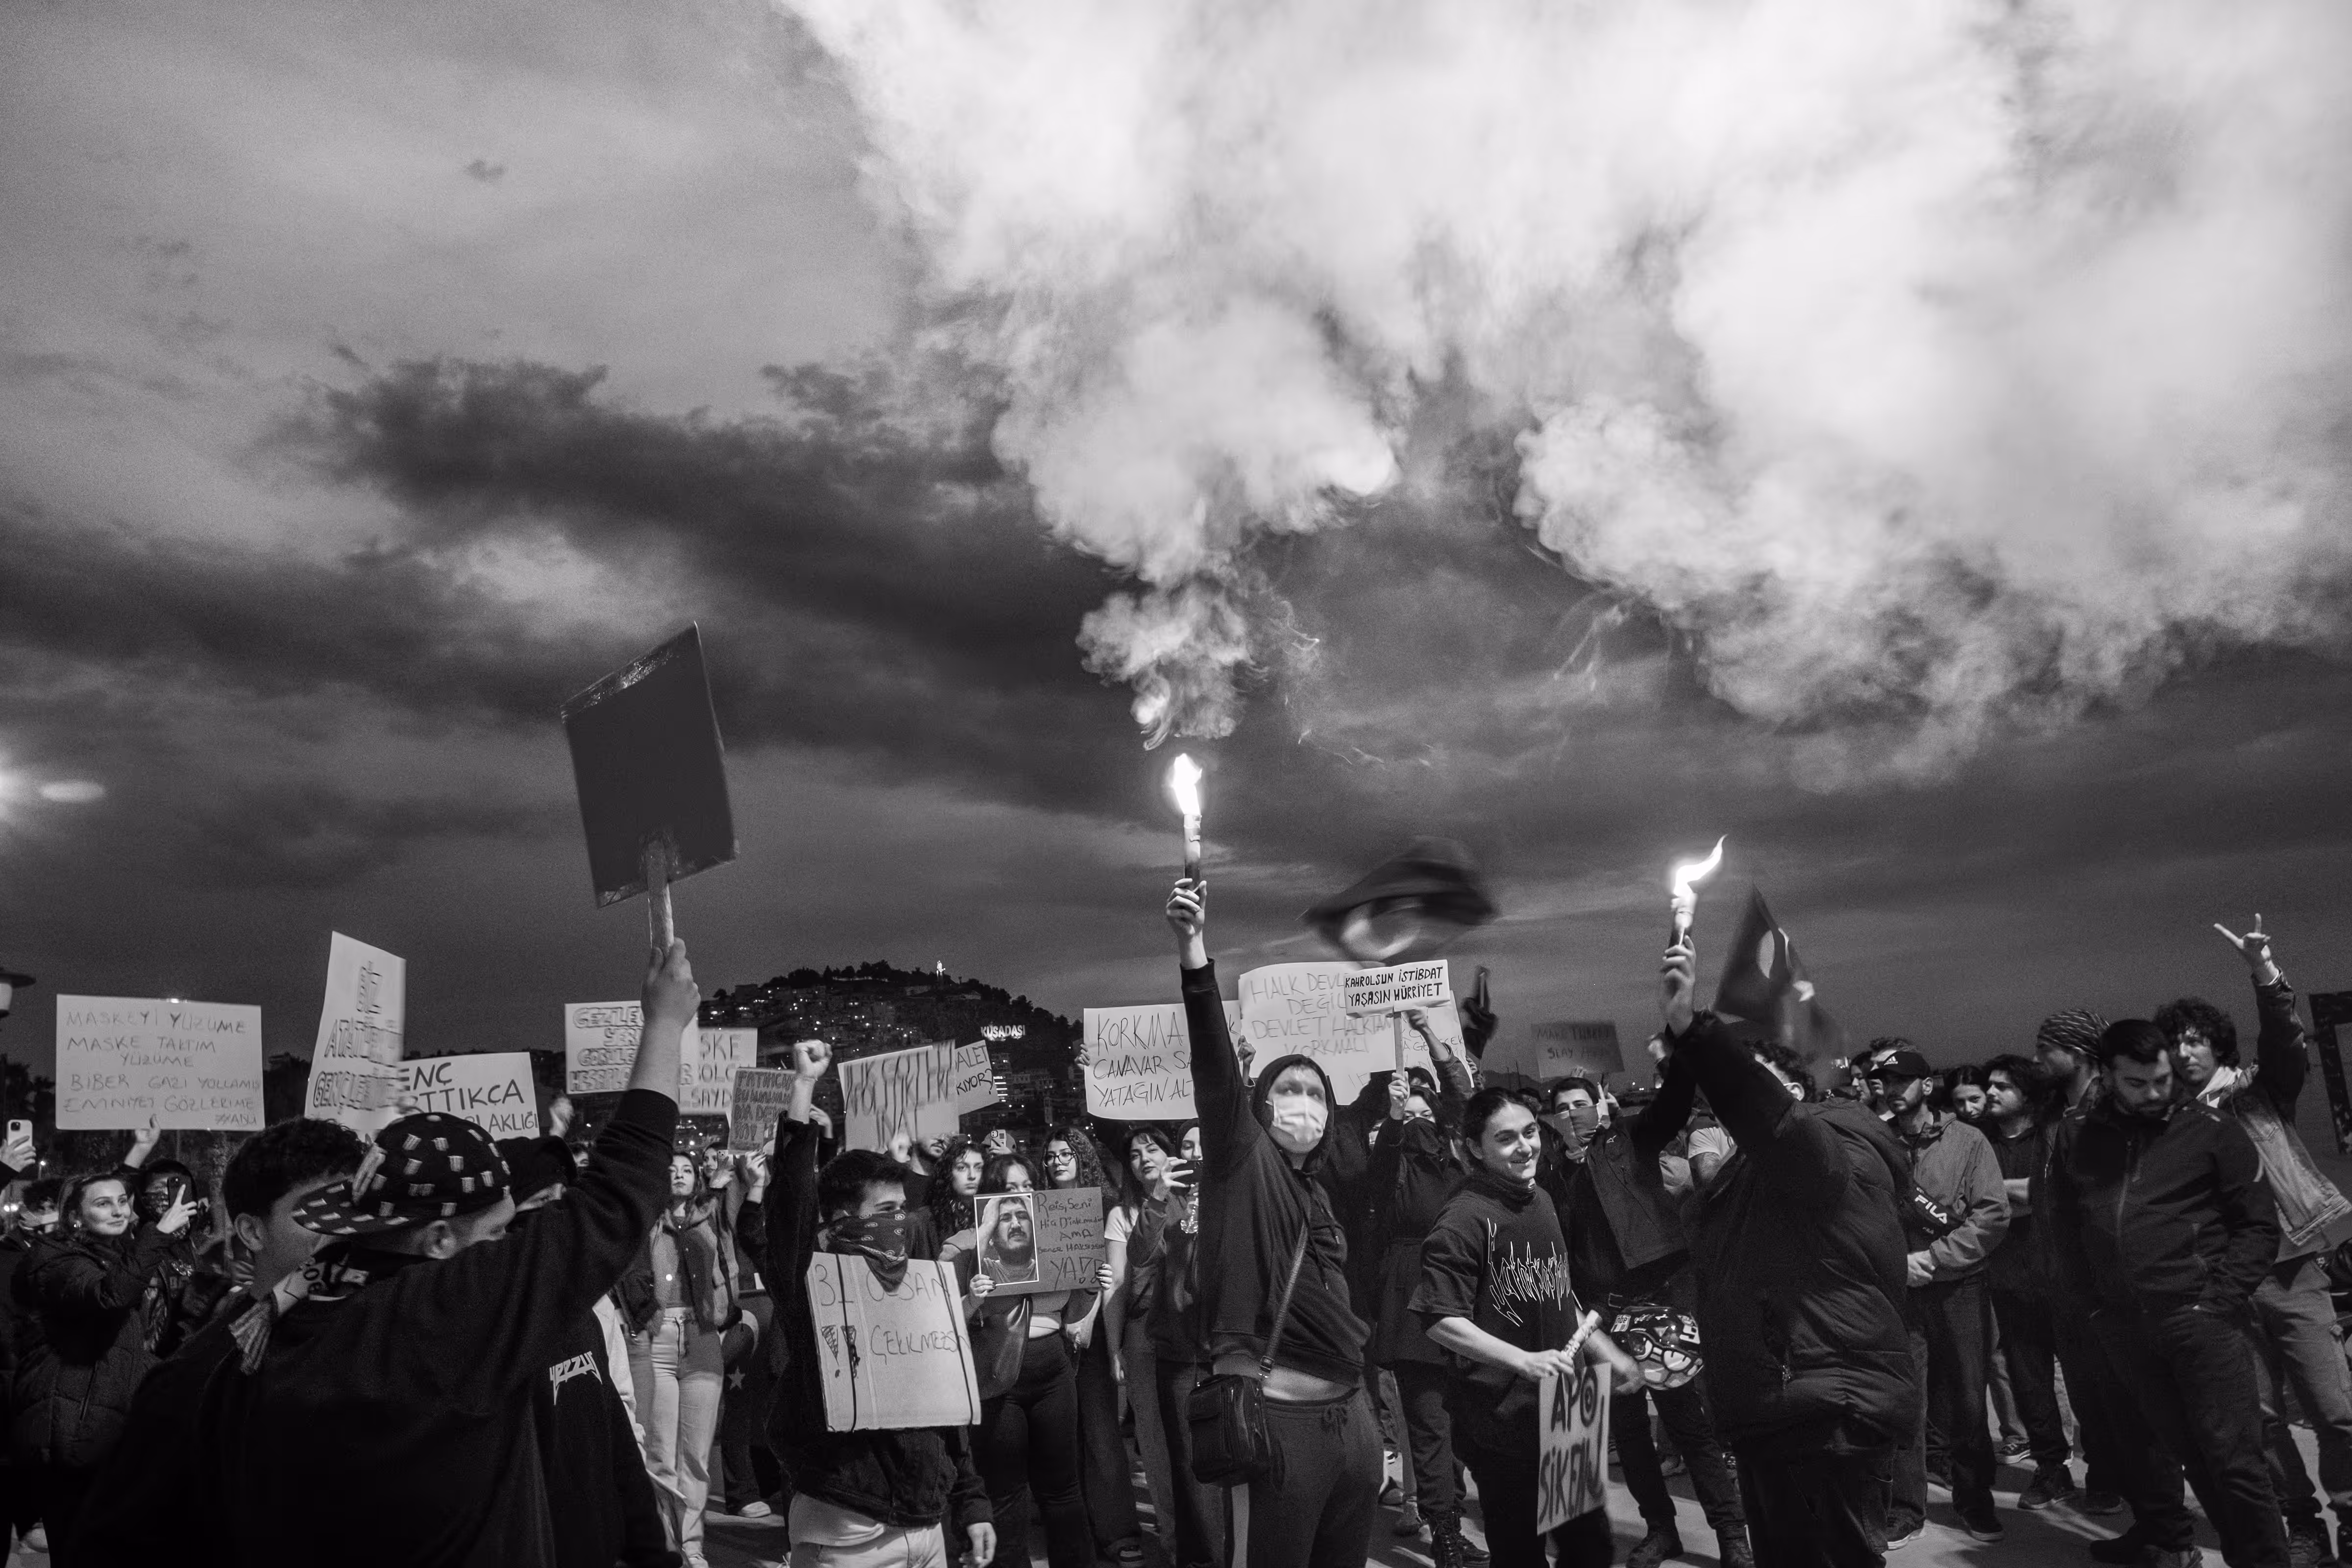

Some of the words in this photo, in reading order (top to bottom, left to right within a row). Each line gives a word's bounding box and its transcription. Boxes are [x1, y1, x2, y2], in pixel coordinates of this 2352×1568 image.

[1250, 974, 1305, 1004] HALK
[1307, 972, 1346, 992] DEVL
[1345, 973, 1394, 989] KAHROLSUN
[1398, 966, 1444, 982] İSTİBDAT
[1348, 989, 1391, 1007] YAŞASIN
[1394, 982, 1443, 1001] HÜRRİYET
[1098, 1012, 1184, 1056] KORKMA
[1251, 1016, 1327, 1039] DEVLET
[67, 1036, 141, 1052] MASKE
[955, 1045, 988, 1072] ALET
[1093, 1055, 1173, 1079] CANAVAR
[1093, 1077, 1169, 1107] YATAĞIN
[1914, 1195, 1948, 1225] FILA
[1550, 1365, 1598, 1433] APO
